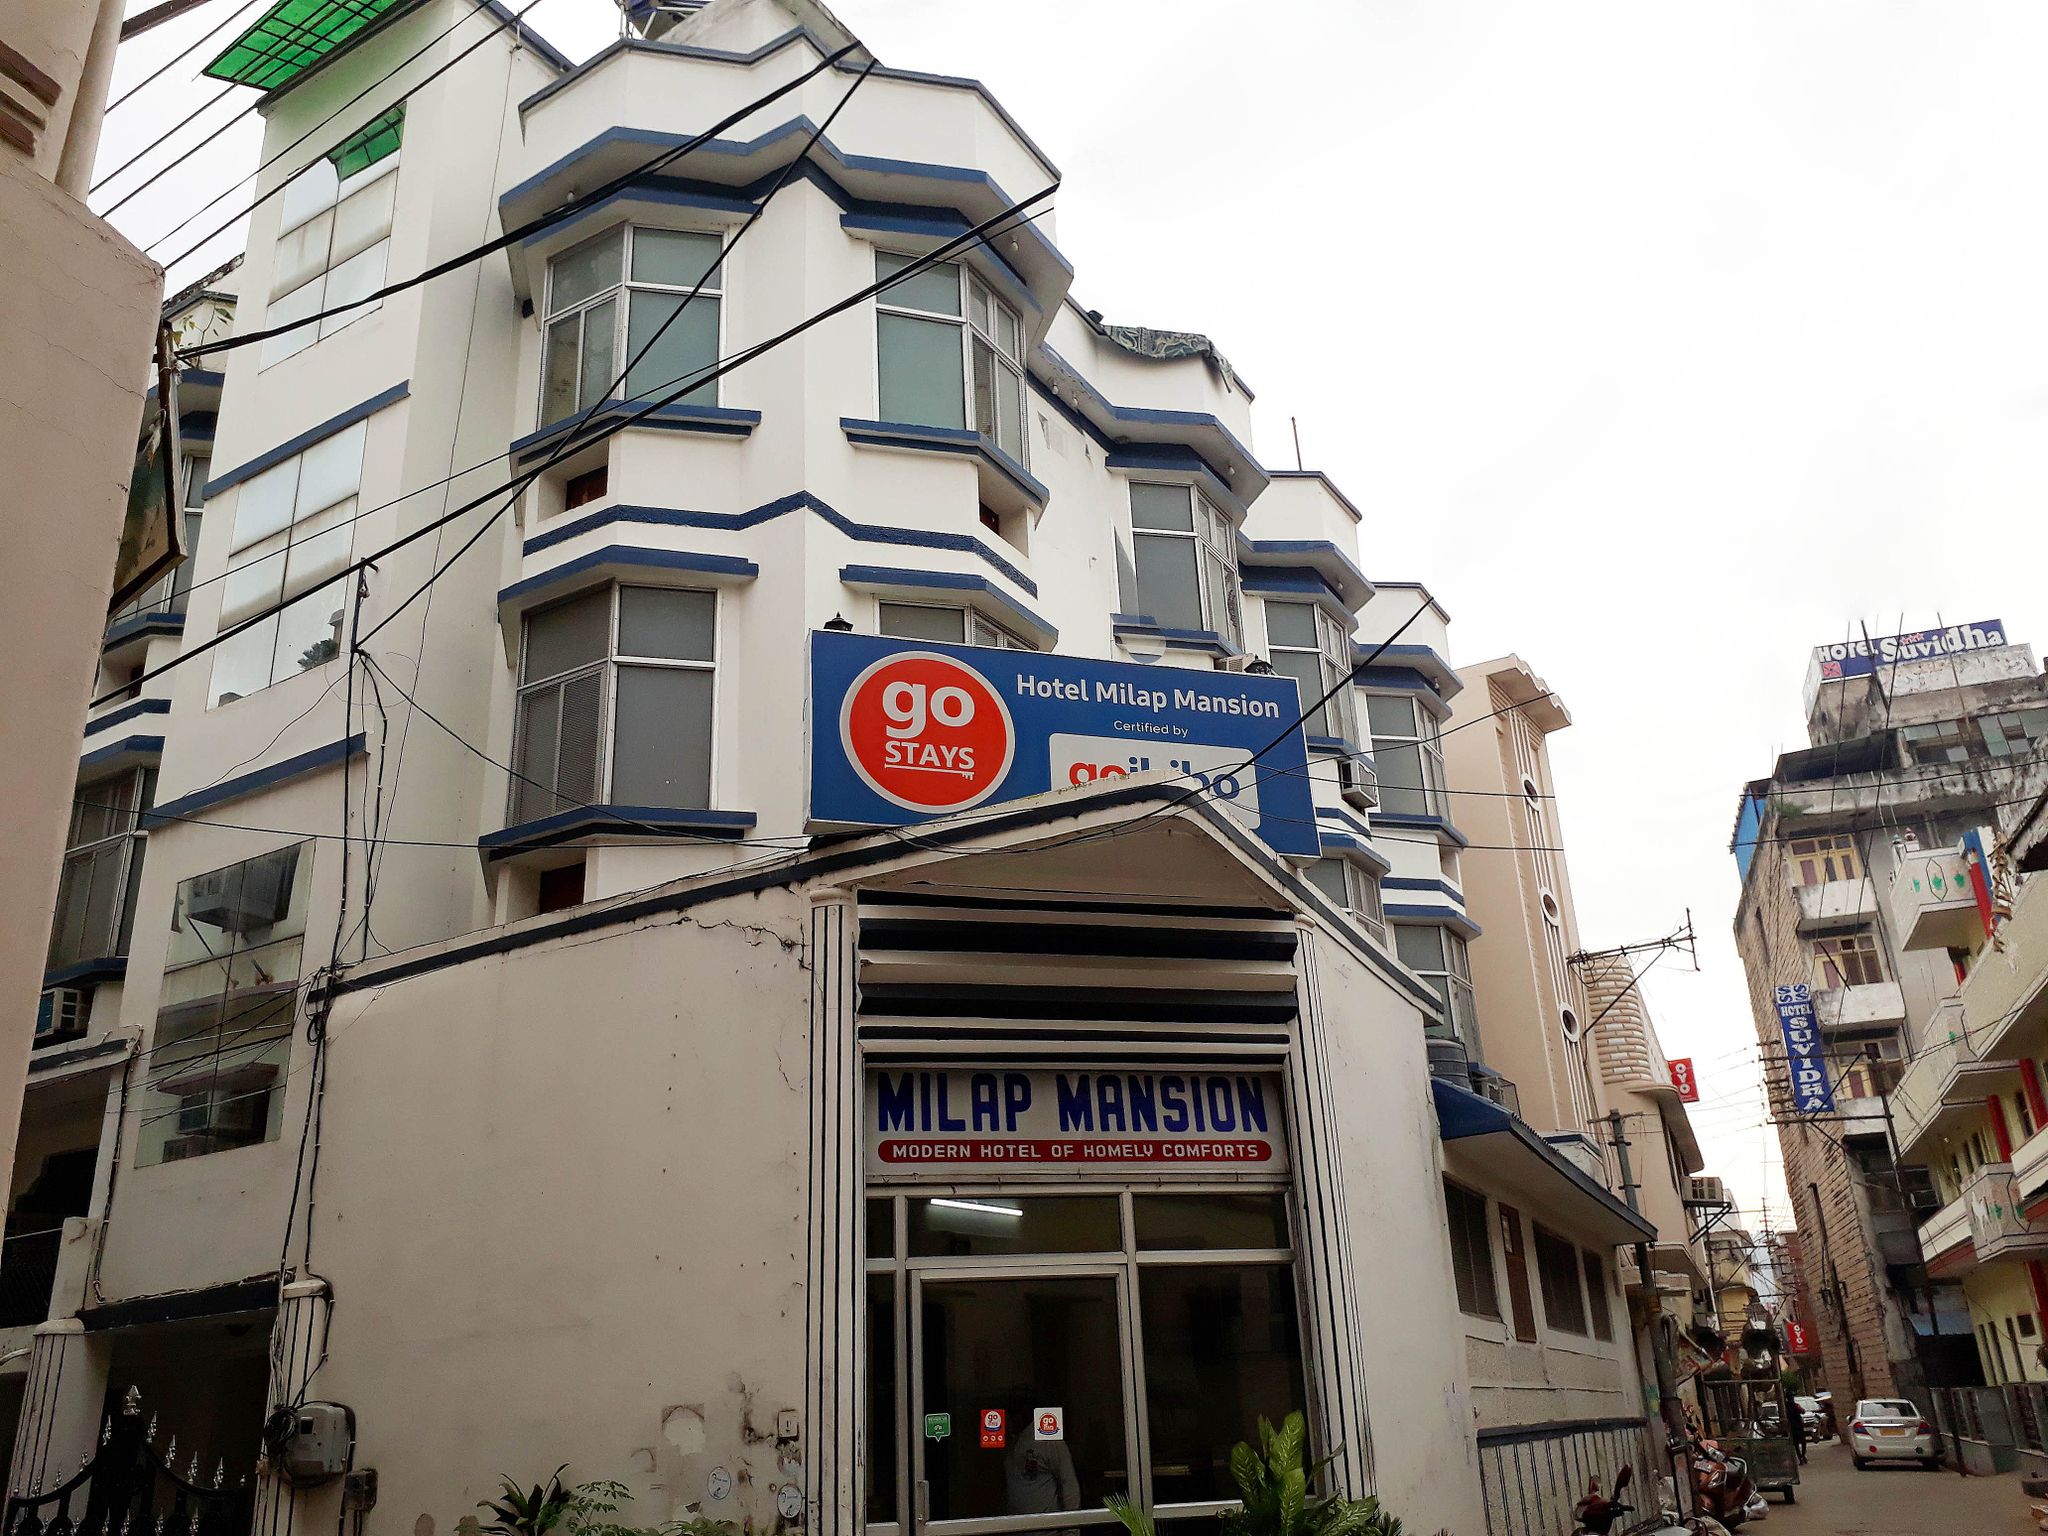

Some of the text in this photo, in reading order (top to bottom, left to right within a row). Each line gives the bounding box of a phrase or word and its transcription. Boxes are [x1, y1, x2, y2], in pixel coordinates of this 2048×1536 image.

[1880, 624, 2003, 662] Suvidha
[881, 680, 976, 738] go
[1016, 674, 1280, 719] Hotel Milap Mansion
[1113, 719, 1188, 739] Certified by
[885, 740, 975, 770] STAYS
[1780, 1004, 1813, 1017] HOTEL
[1675, 1062, 1691, 1095] OYO
[1789, 1016, 1828, 1110] SUVIDHA
[877, 1071, 1268, 1133] MILAP MANSION
[892, 1143, 1258, 1159] MODERN HOTEL OF HOMELY COMFORTS
[1793, 1324, 1803, 1344] OYO
[1042, 1417, 1054, 1428] go
